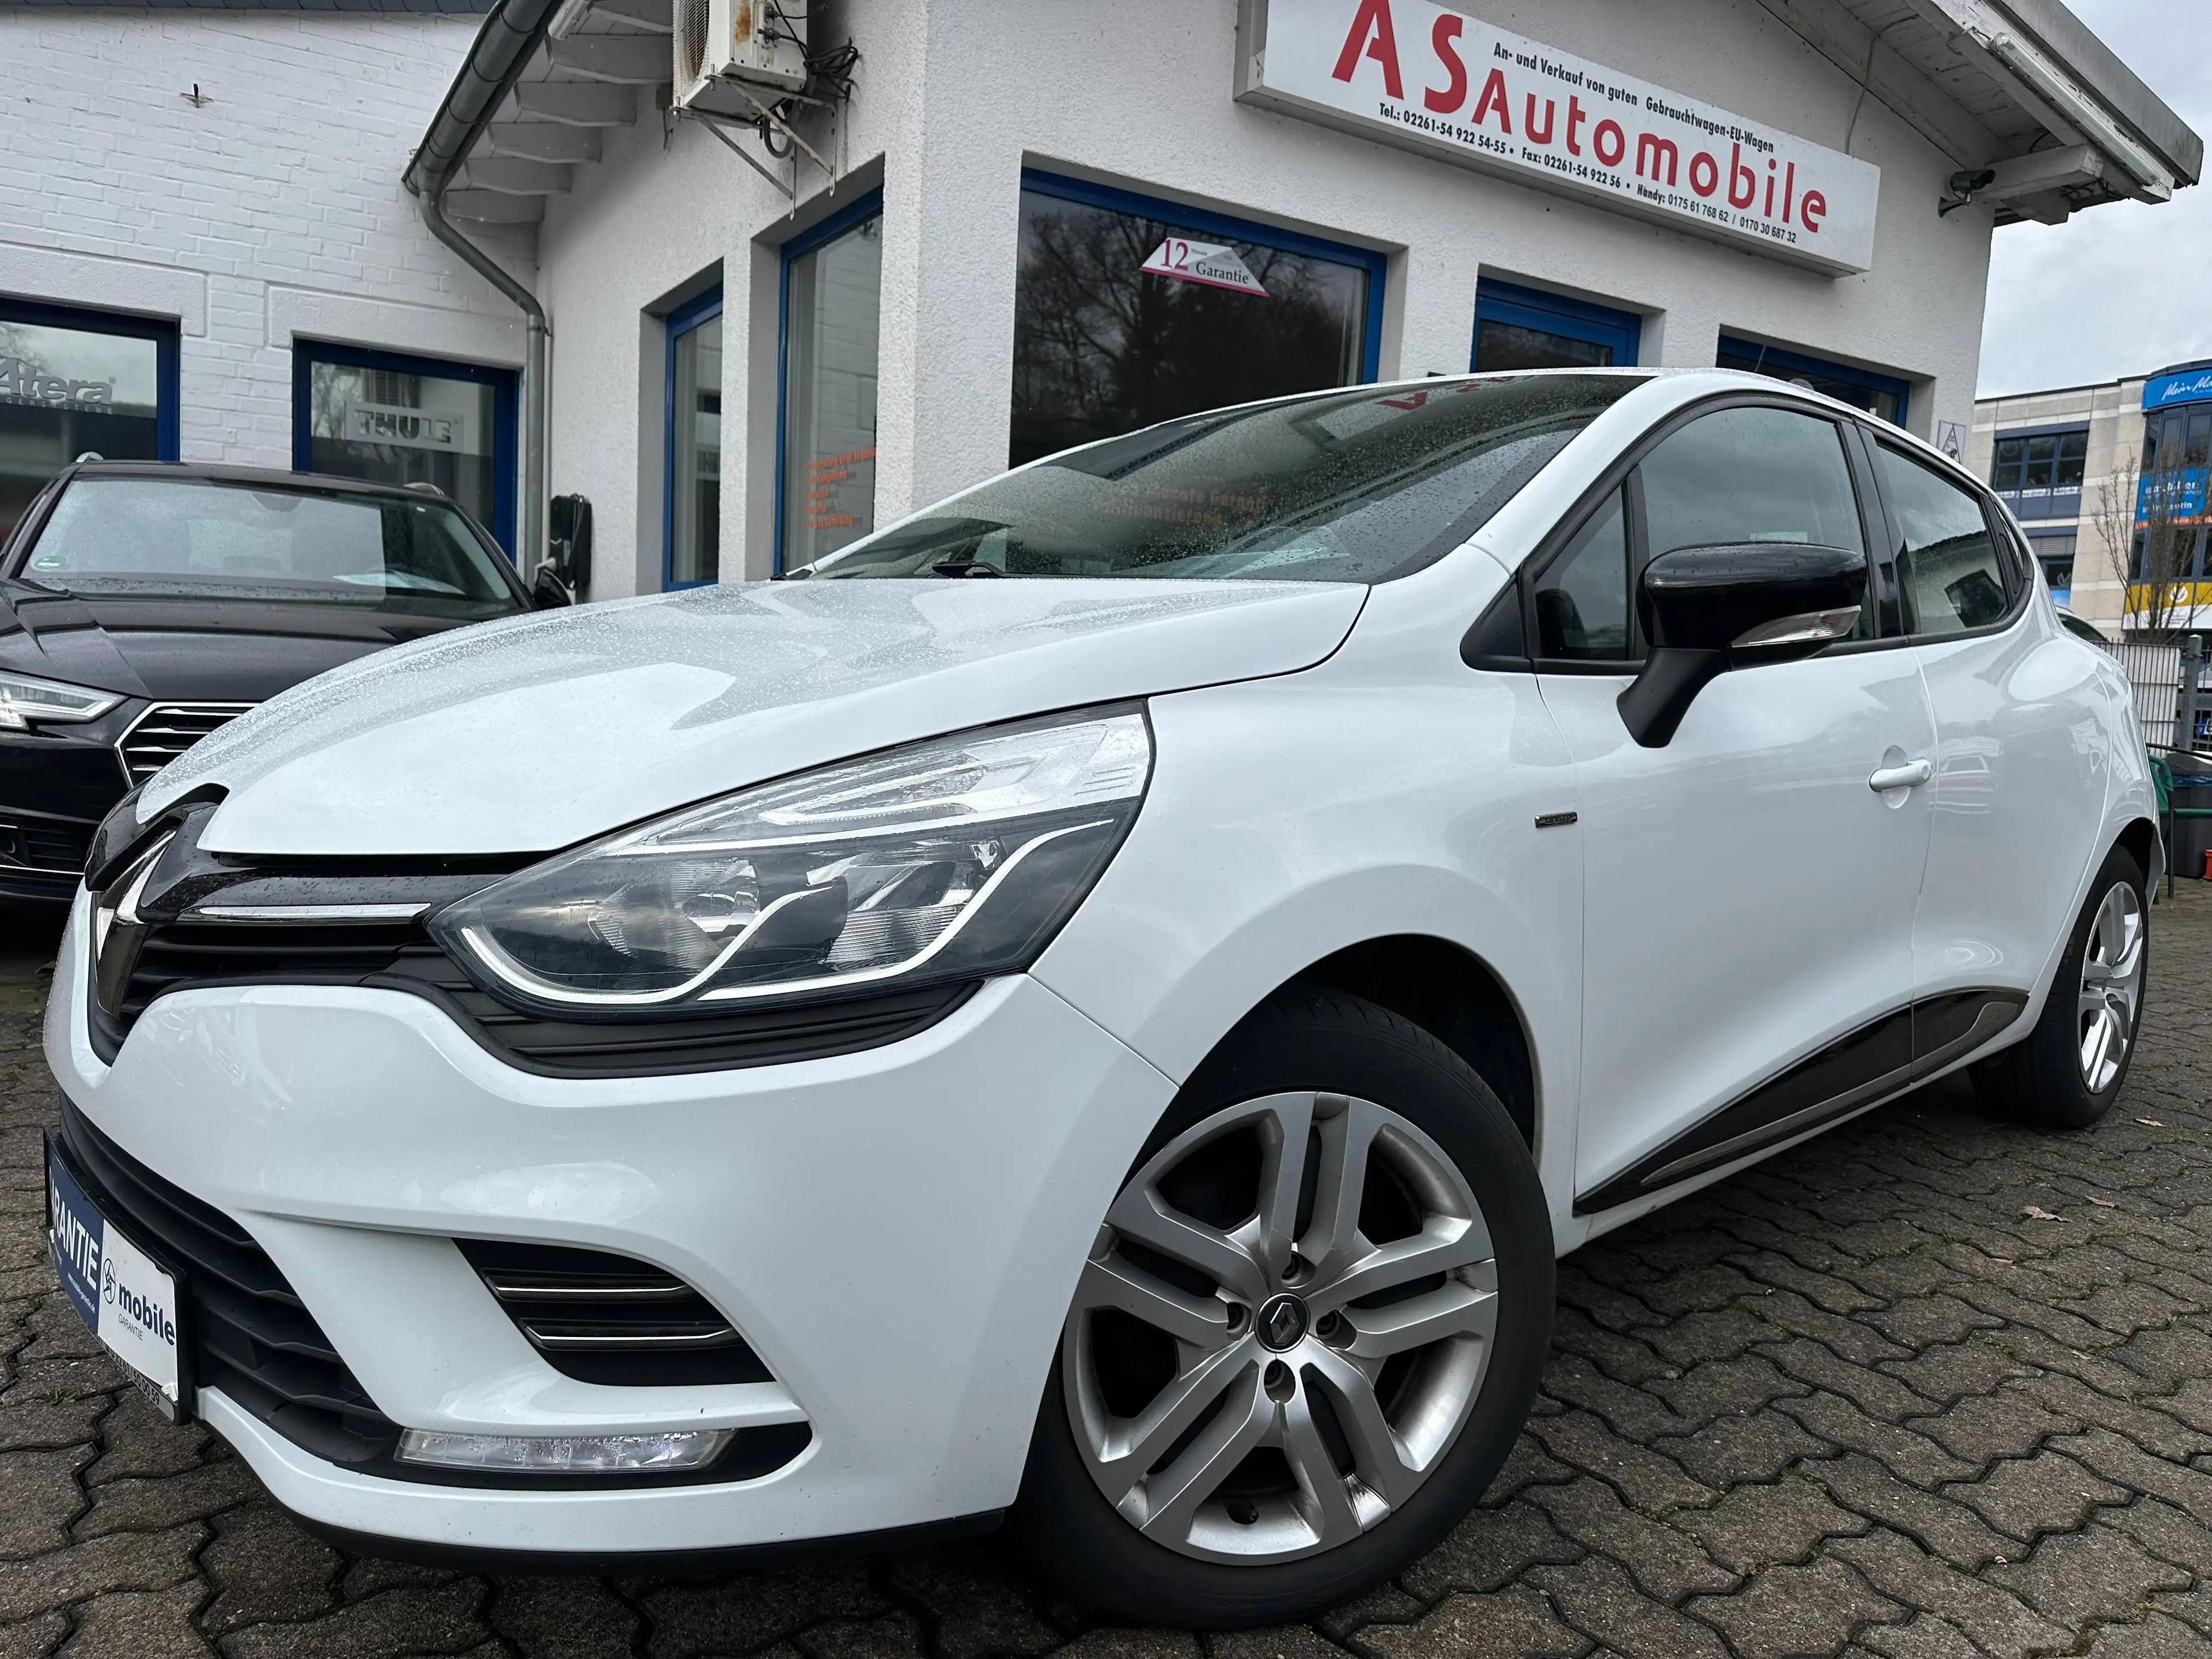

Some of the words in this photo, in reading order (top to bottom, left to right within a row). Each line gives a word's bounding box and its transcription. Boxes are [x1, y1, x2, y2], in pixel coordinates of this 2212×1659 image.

[1494, 42, 1512, 60] An-
[1516, 53, 1537, 70] und
[1540, 58, 1583, 86] Verkauf
[1586, 78, 1604, 94] von
[1608, 86, 1637, 106] guten
[1380, 103, 1400, 120] Tel.:
[1404, 110, 1452, 138] 02261-54
[1457, 127, 1475, 144] 922
[1478, 134, 1506, 154] 54-55
[1522, 147, 1541, 164] Fax:
[1544, 154, 1587, 177] 02261-54
[1590, 169, 1607, 184] 922
[1609, 175, 1620, 188] 56
[1637, 183, 1665, 204] Handy:
[1668, 194, 1688, 209] 0175
[1690, 200, 1700, 213] 61
[1703, 204, 1716, 218] 768
[1719, 209, 1728, 222] 62
[1740, 217, 1759, 231] 0170
[1760, 223, 1770, 236] 30
[1771, 226, 1785, 240] 687
[1787, 232, 1797, 244] 32
[1161, 238, 1188, 271] 12
[1196, 262, 1249, 285] Garantie
[355, 409, 451, 444] THULE
[118, 1313, 143, 1341] GARANTIE
[119, 1282, 175, 1346] mobile
